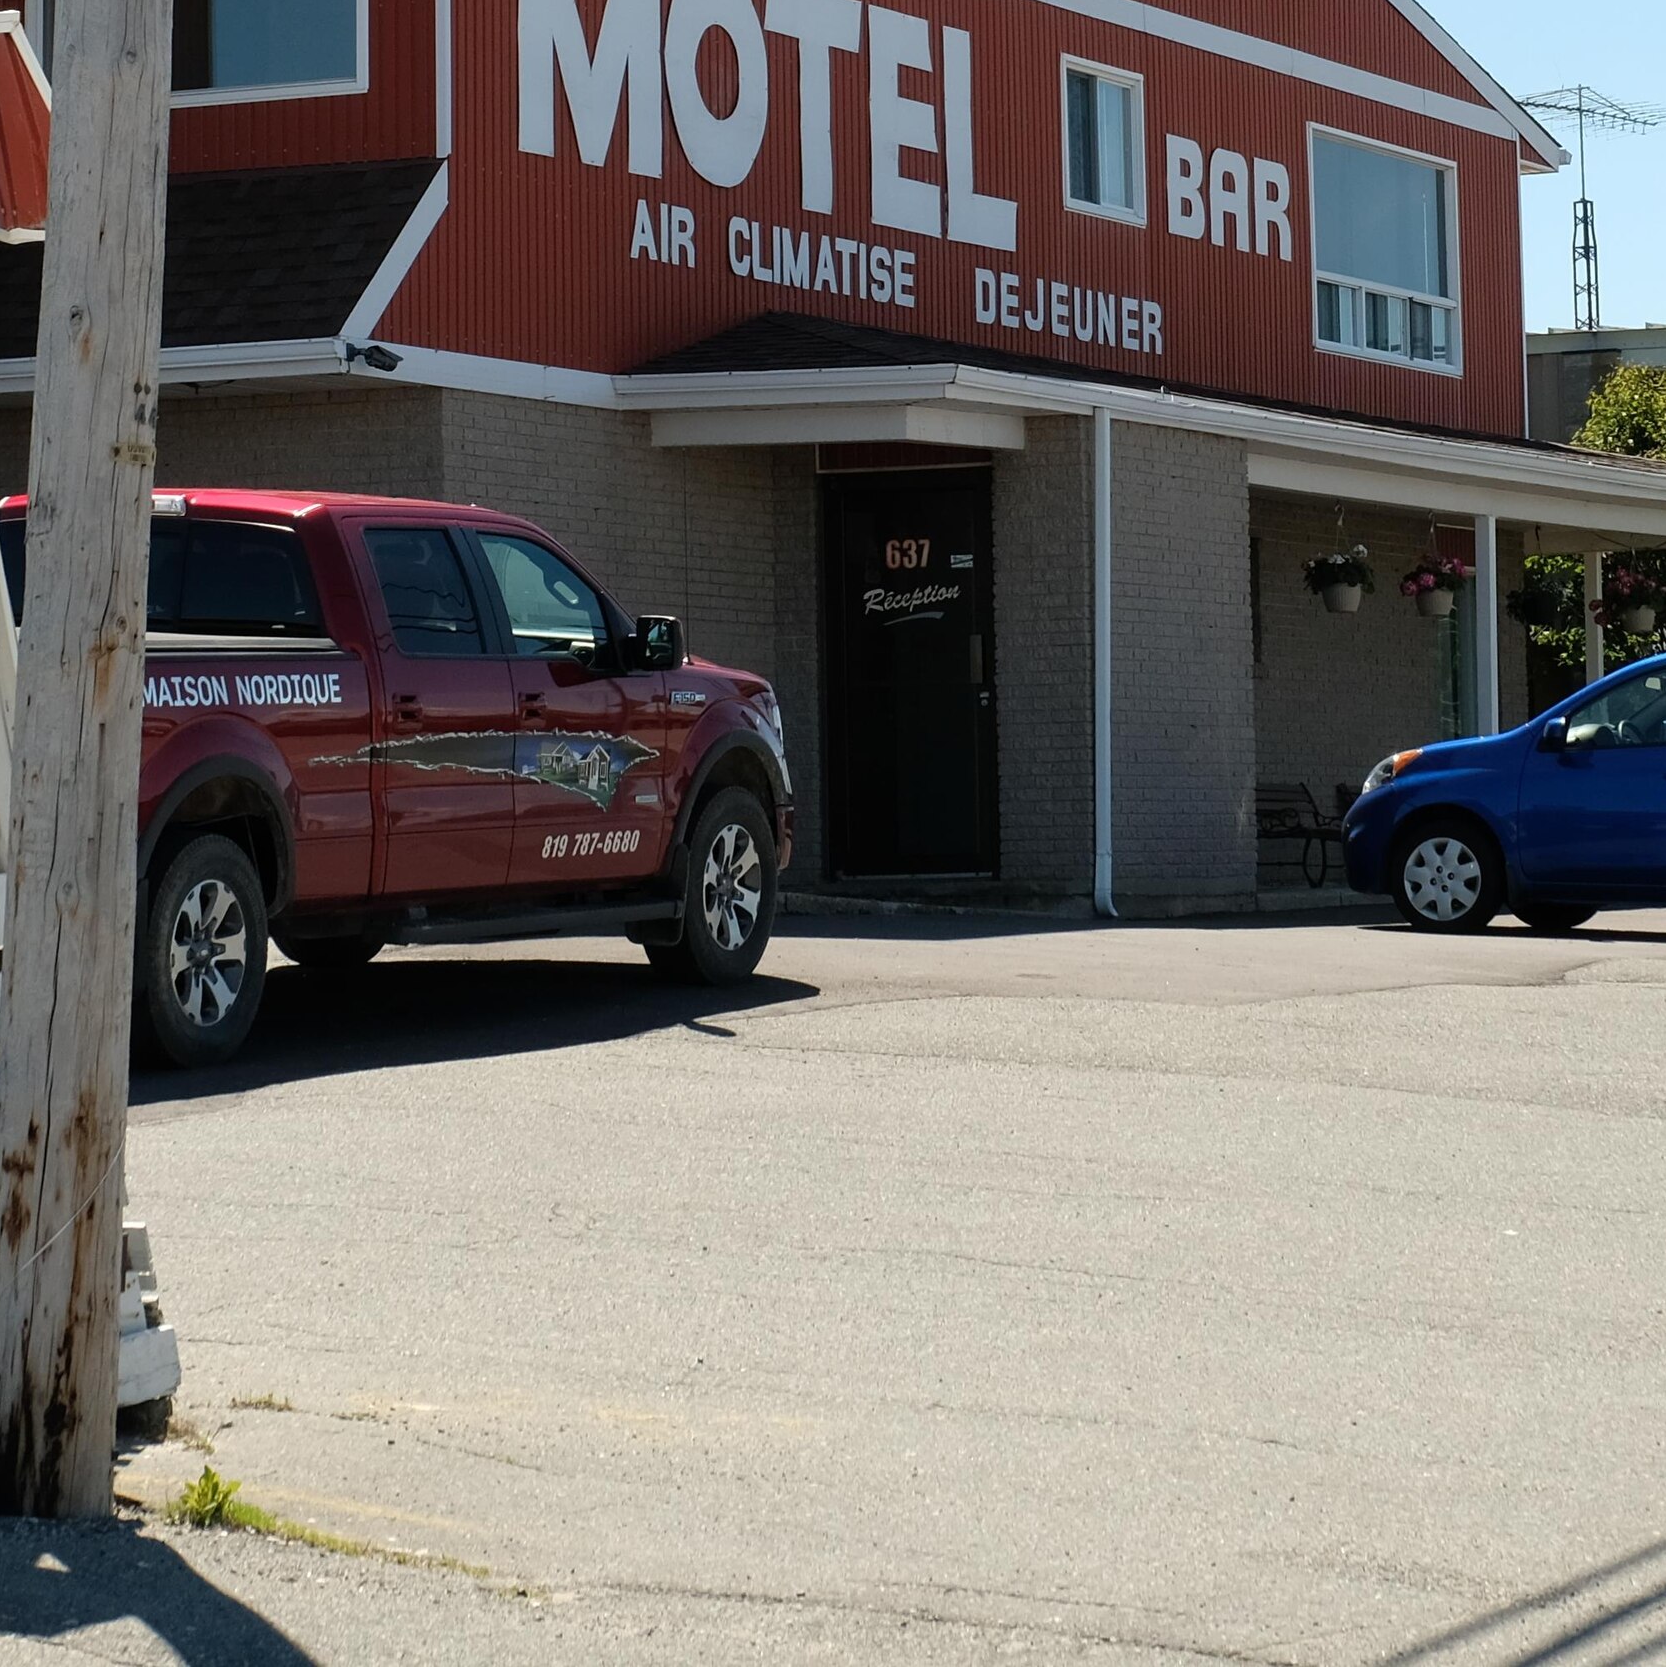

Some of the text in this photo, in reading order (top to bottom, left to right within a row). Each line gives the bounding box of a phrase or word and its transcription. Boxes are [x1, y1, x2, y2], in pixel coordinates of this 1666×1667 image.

[1166, 133, 1291, 261] BAR
[630, 199, 1163, 355] AIR CLIMATISE DEJEUNER
[886, 539, 930, 569] 637
[863, 585, 960, 615] Réception
[142, 674, 342, 707] MAISON NORDIQUE
[542, 830, 640, 858] 819 787-6680
